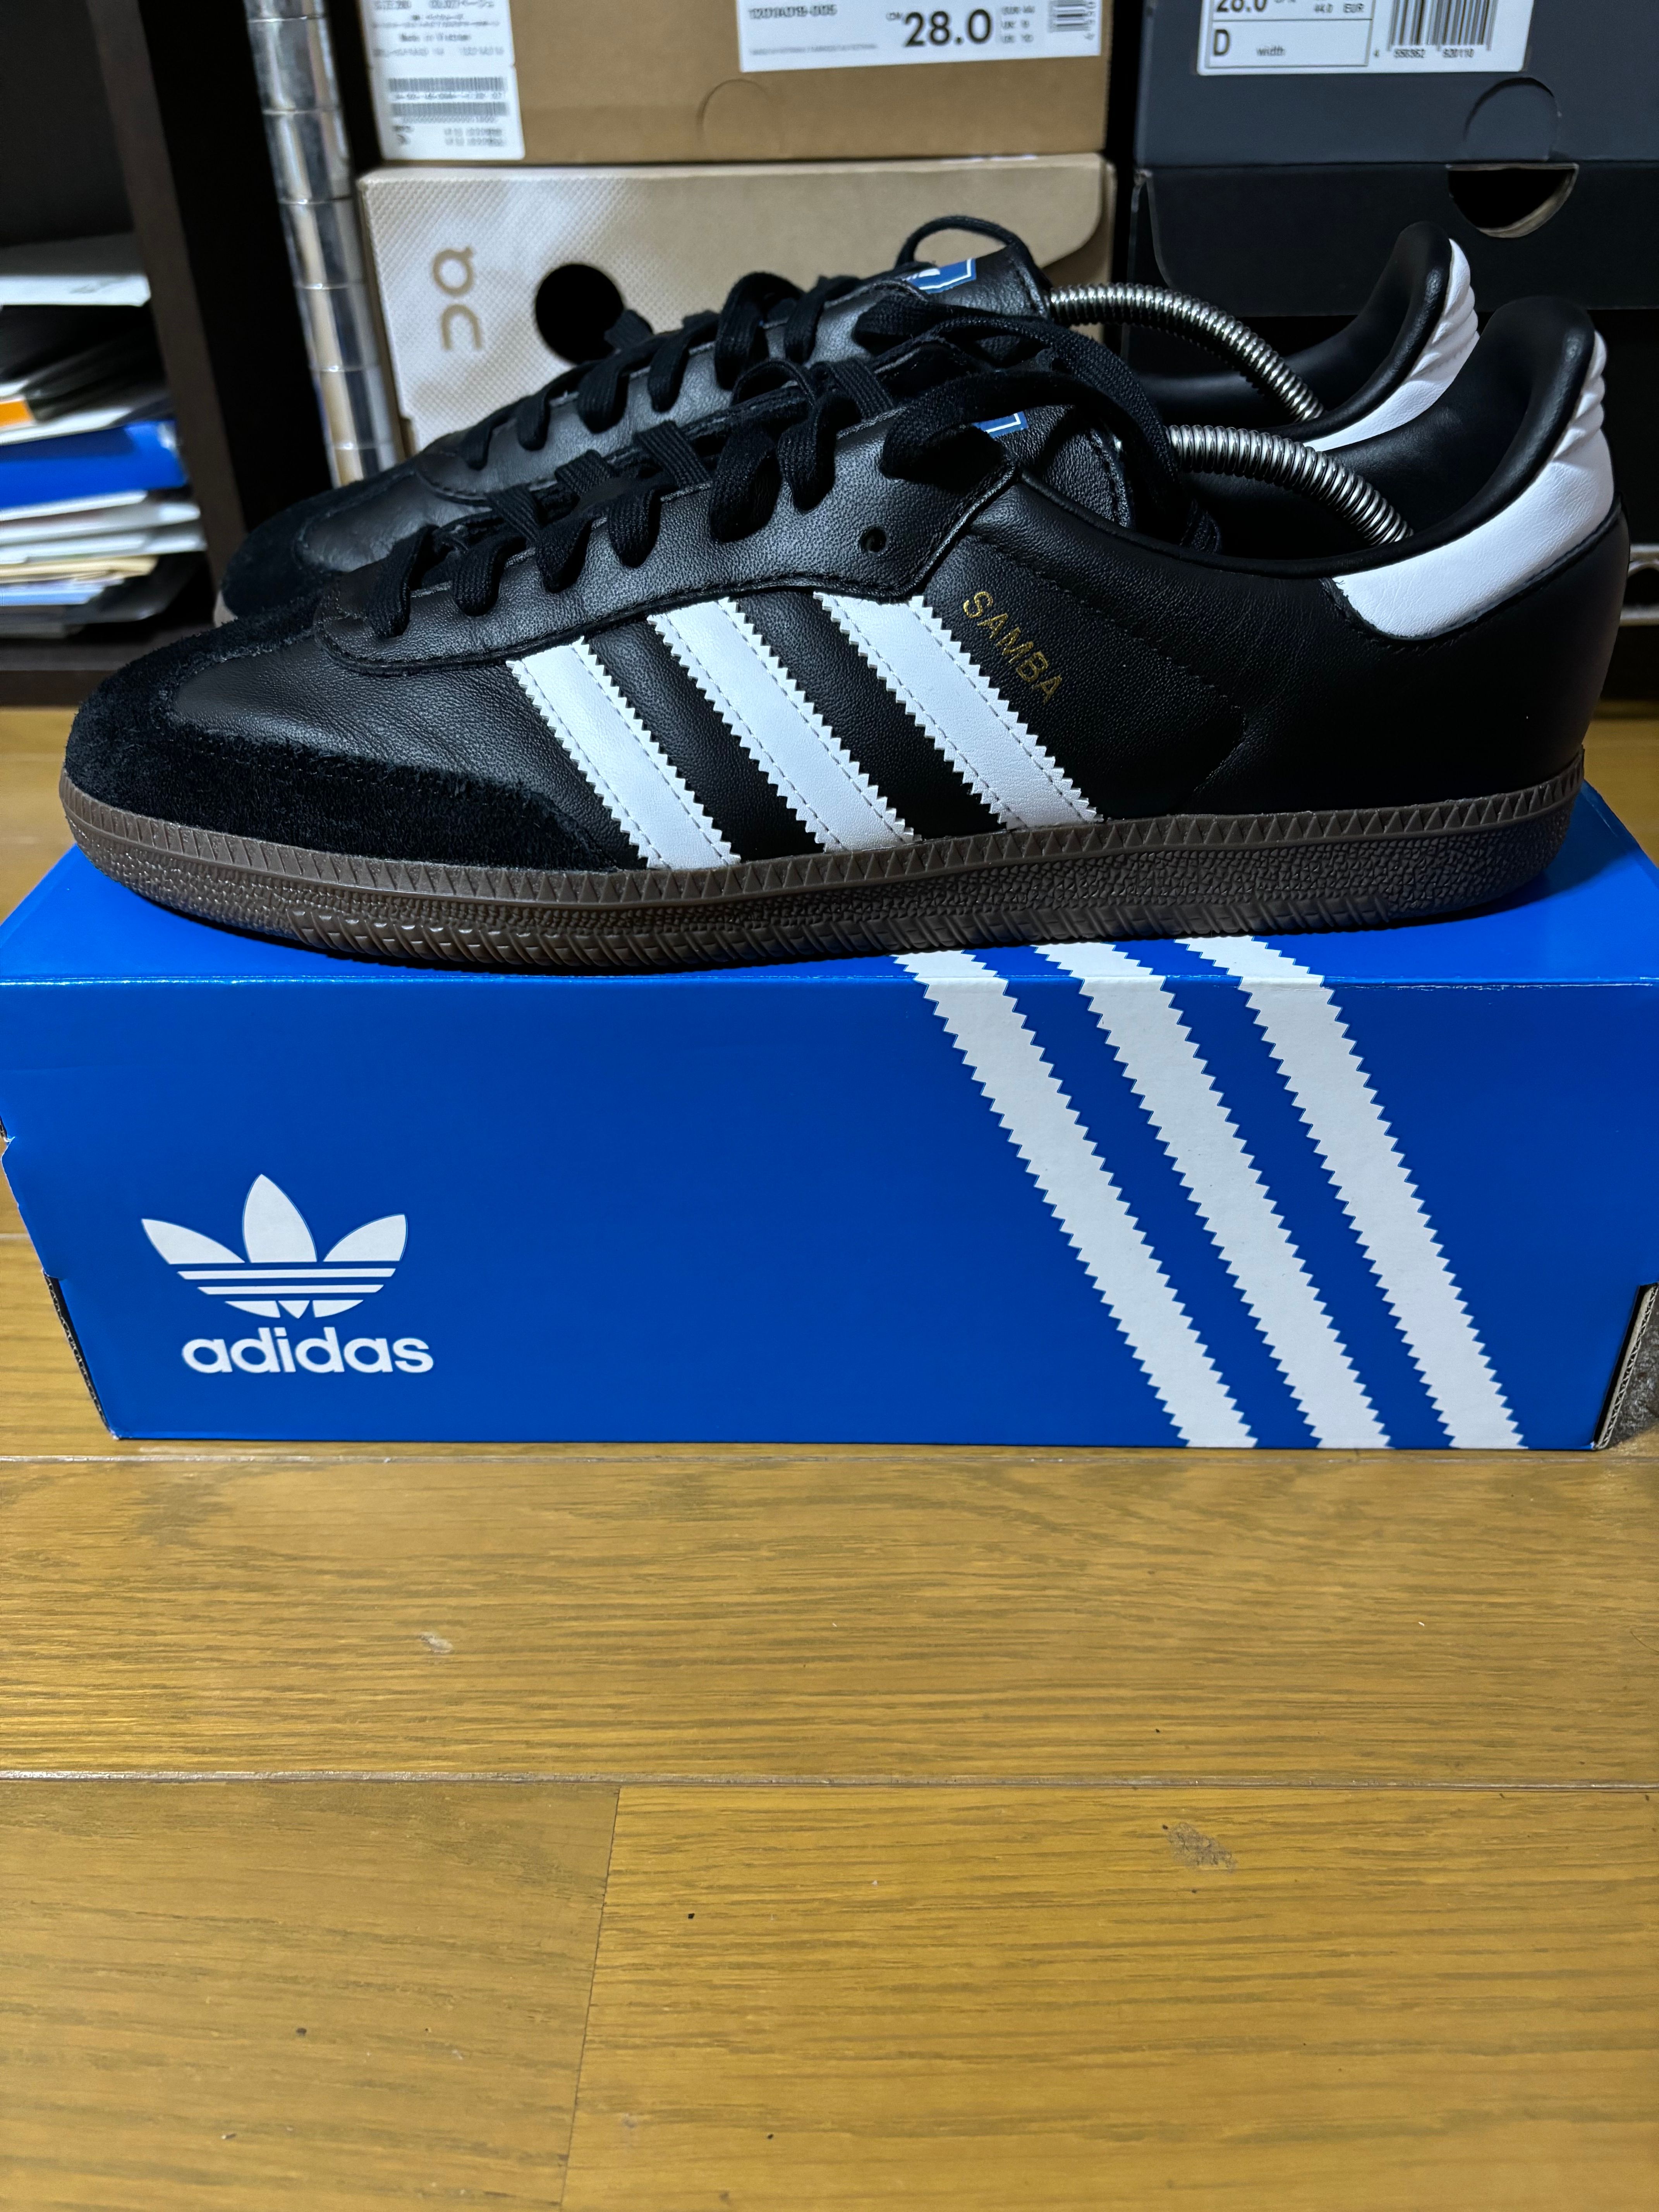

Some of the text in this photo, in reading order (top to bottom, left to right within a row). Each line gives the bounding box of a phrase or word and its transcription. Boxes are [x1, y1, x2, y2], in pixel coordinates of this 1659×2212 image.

[1343, 3, 1364, 13] EUR
[903, 9, 992, 47] 28.0
[1213, 29, 1231, 56] D
[1256, 46, 1285, 56] width
[963, 591, 1062, 704] SAMBA
[182, 1327, 434, 1373] adidas
